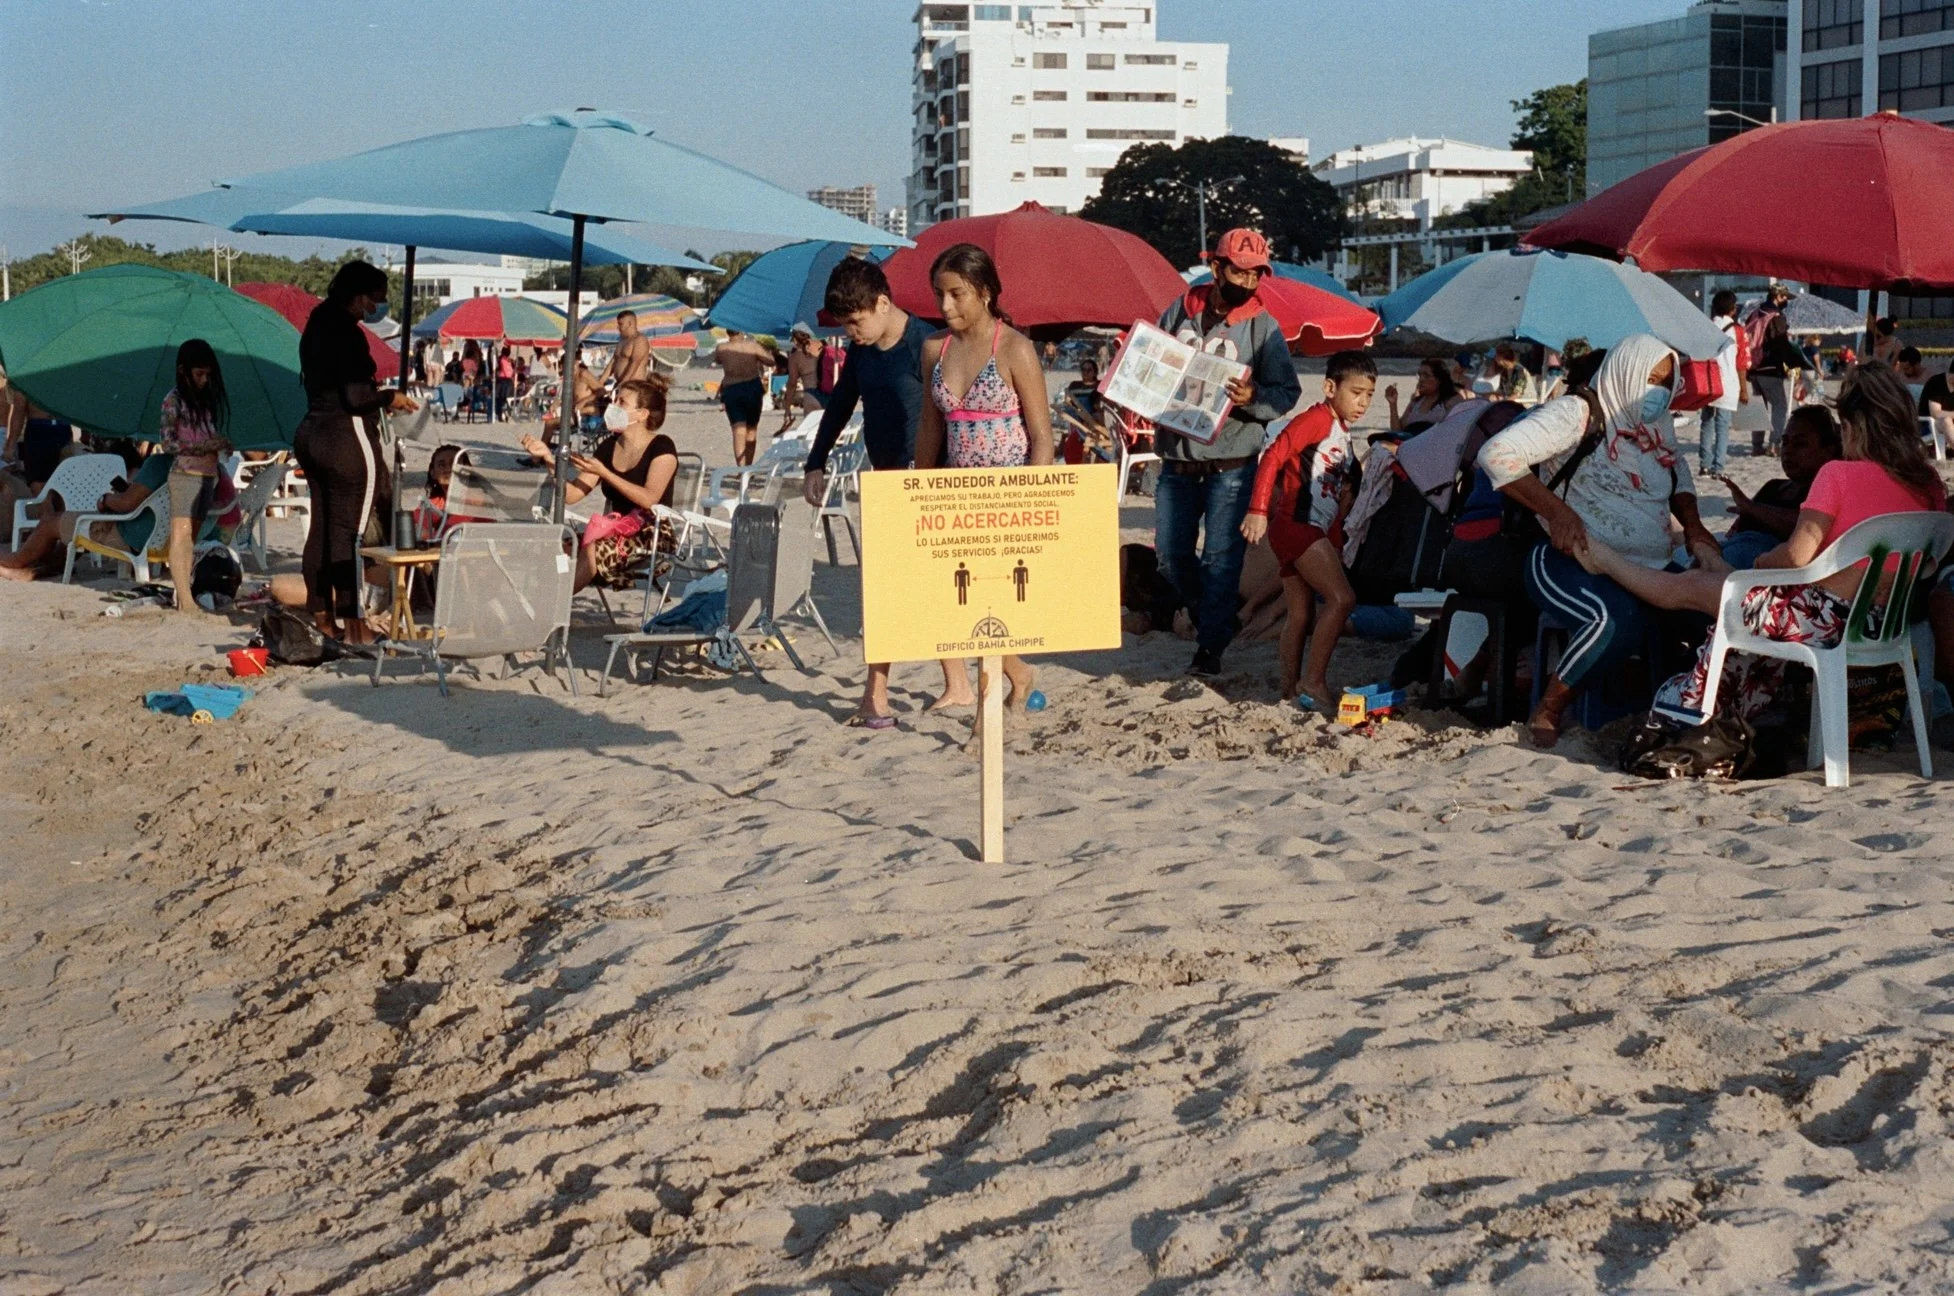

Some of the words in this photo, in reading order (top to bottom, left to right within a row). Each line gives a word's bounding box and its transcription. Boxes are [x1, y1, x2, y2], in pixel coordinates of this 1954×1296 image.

[904, 478, 923, 490] SR.
[927, 476, 995, 489] VENDEDOR
[1000, 473, 1078, 486] AMBULANTE:
[910, 494, 955, 502] APRECIAMOS
[970, 501, 1031, 509] DISTANCIAMIENTO
[916, 515, 945, 535] ¡NO
[952, 511, 1059, 529] ACERCARSE!
[916, 538, 927, 547] LO
[930, 536, 990, 546] LLAMAREMOS
[993, 535, 1001, 543] SI
[1004, 532, 1059, 542] REQUERIMOS
[932, 550, 949, 558] SUS
[952, 548, 996, 557] SERVICIOS
[1002, 546, 1043, 557] ¡GRACIAS!
[936, 642, 974, 652] EDIFICIO
[1009, 637, 1044, 647] CHIPIPE
